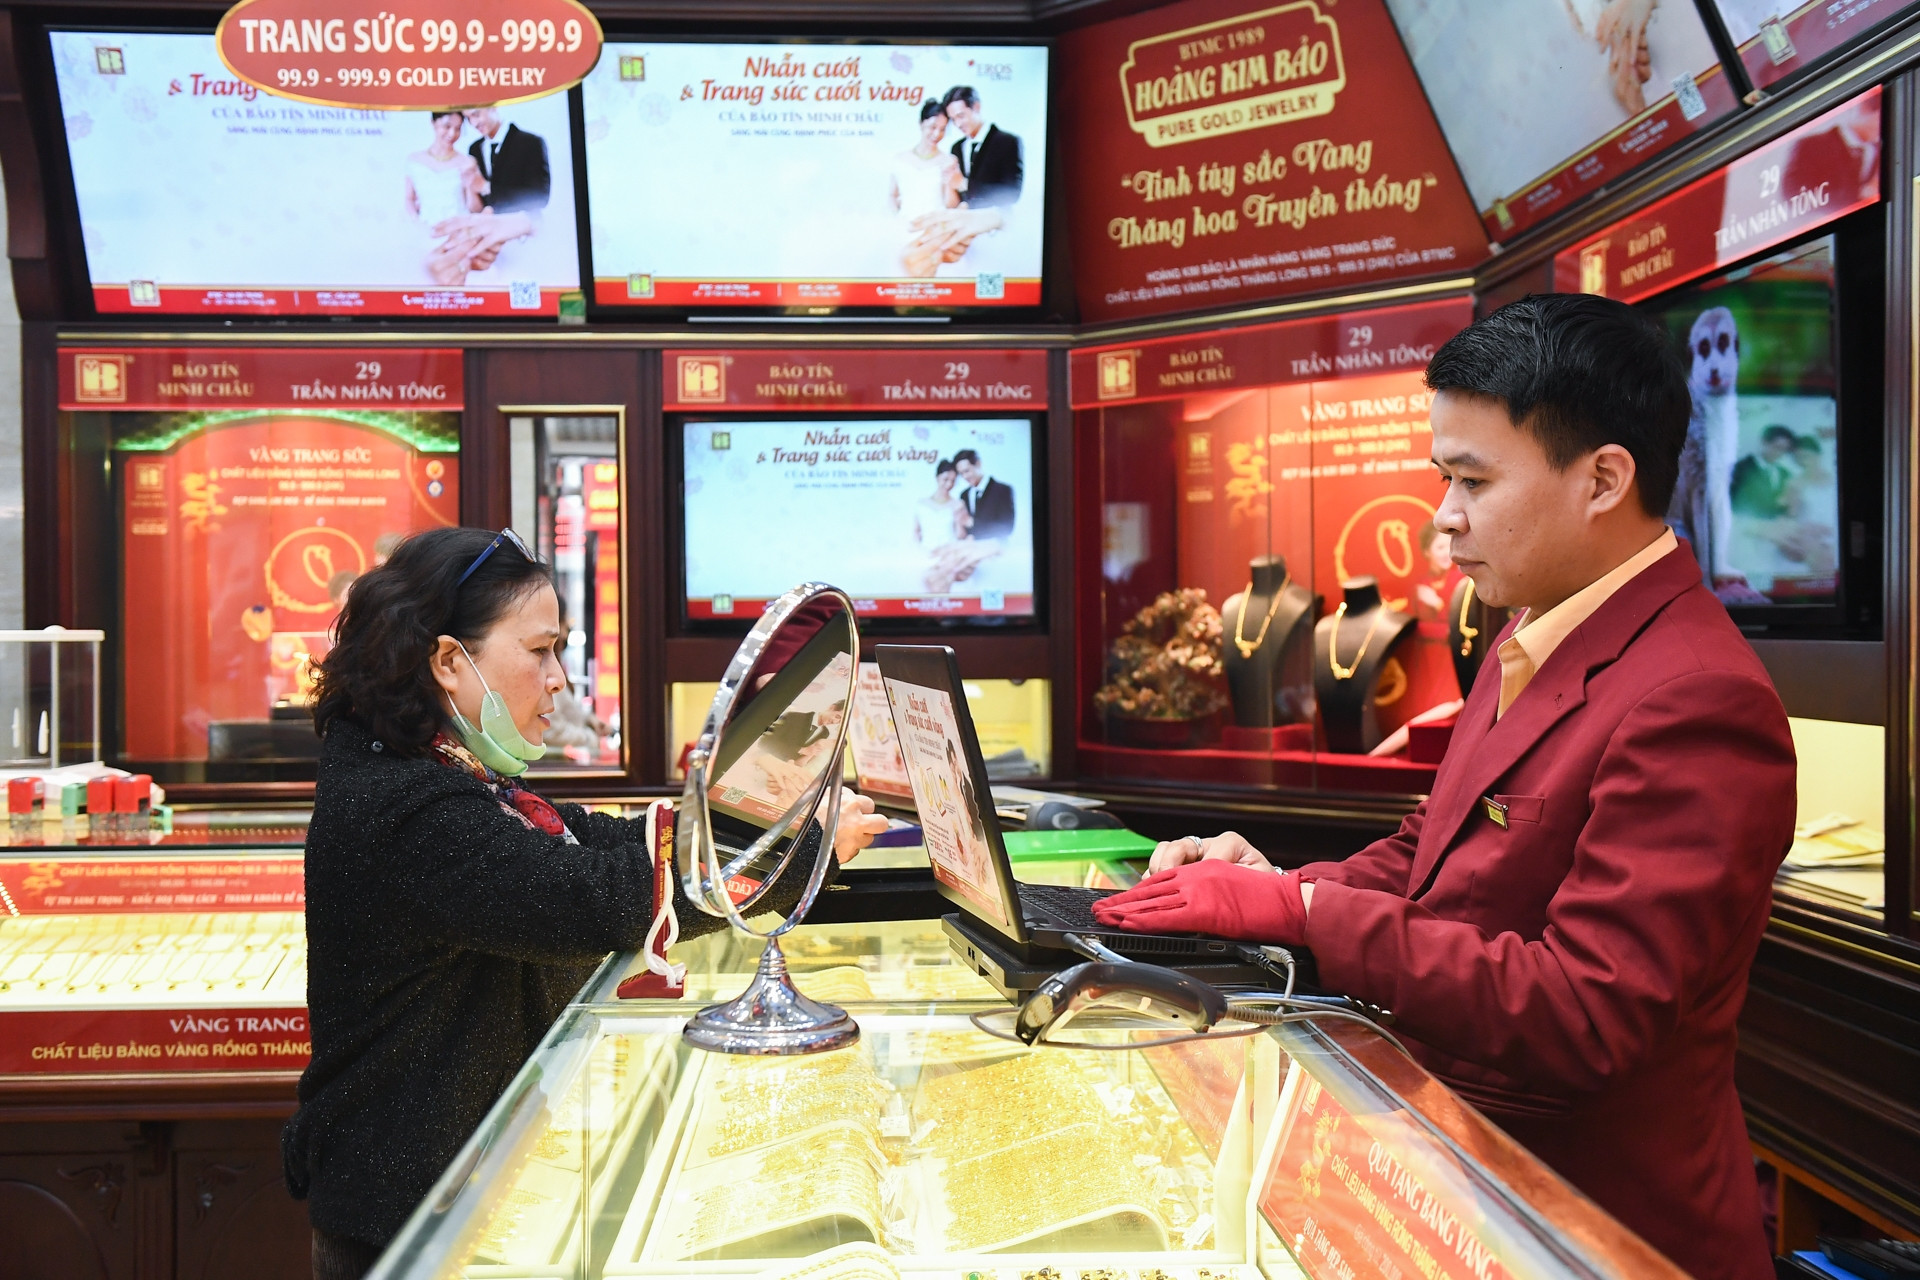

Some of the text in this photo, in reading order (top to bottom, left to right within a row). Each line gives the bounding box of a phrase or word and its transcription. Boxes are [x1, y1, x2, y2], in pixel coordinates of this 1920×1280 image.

[240, 19, 346, 53] TRANG
[353, 11, 415, 53] SỨC
[1178, 26, 1265, 61] BTMC 1989
[743, 52, 805, 78] Nhẫn
[1135, 35, 1328, 112] HOÀNG KIM BẢO
[277, 68, 320, 88] 99.9
[337, 68, 391, 88] 999.9
[396, 67, 454, 88] GOLD
[459, 67, 546, 89] JEWELRY
[680, 86, 693, 101] &
[700, 79, 764, 106] Trang
[869, 80, 924, 106] vàng
[1157, 93, 1318, 139] PURE GOLD JEWELRY
[1292, 138, 1372, 174] Vàng
[1759, 165, 1780, 198] 29
[1193, 206, 1238, 237] hoa
[1714, 181, 1829, 251] TRẦN NHÂN TÔNG
[1348, 325, 1373, 347] 29
[1170, 345, 1223, 367] BẢO TÍN
[1291, 343, 1434, 376] TRẦN NHÂN TÔNG
[172, 360, 239, 378] BẢO TÍN
[355, 361, 382, 380] 29
[770, 362, 833, 379] BẢO TÍN
[944, 362, 970, 380] 29
[1159, 364, 1234, 387] MINH CHÂU
[158, 379, 253, 397] MINH CHÂU
[291, 378, 446, 400] TRẦN NHÂN TÔNG
[756, 380, 847, 398] MINH CHÂU
[883, 379, 1031, 399] TRẦN NHÂN TÔNG
[1302, 400, 1346, 421] VÀNG
[1350, 396, 1406, 418] TRANG
[249, 445, 371, 463] VÀNG TRANG SỨC
[772, 448, 819, 466] Trang
[898, 448, 938, 464] vàng
[169, 1014, 305, 1033] VÀNG TRANG
[32, 1042, 75, 1060] CHẤT
[78, 1043, 112, 1061] LIỆU
[116, 1039, 161, 1058] BẰNG
[166, 1040, 213, 1057] VÀNG
[261, 1039, 312, 1056] THĂNG
